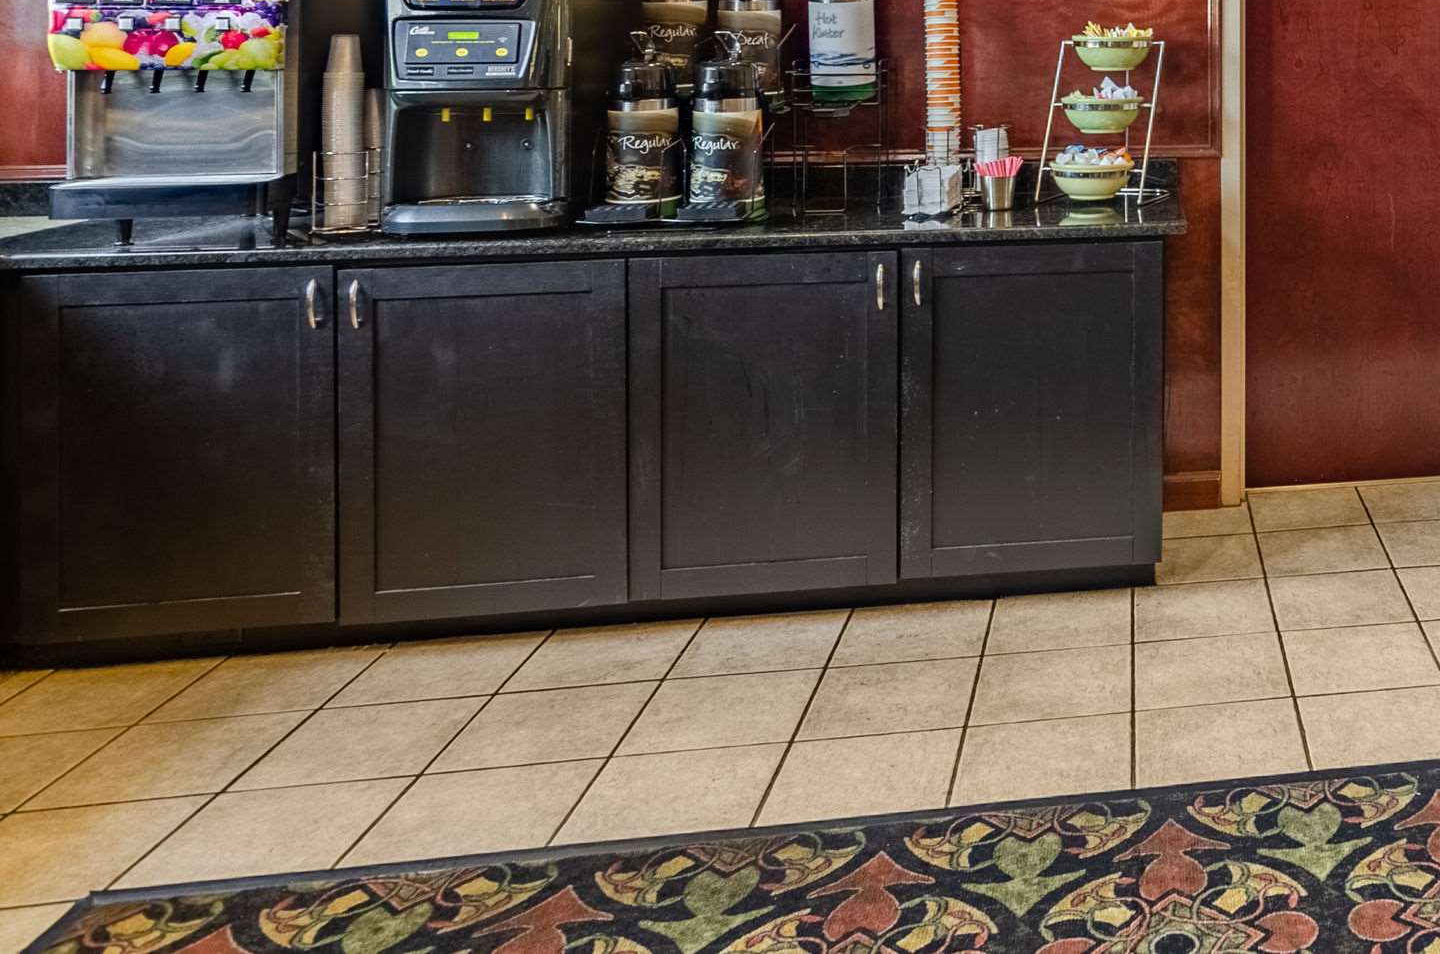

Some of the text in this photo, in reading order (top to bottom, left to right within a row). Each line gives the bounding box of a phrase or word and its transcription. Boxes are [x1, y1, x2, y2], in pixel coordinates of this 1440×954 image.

[815, 11, 838, 25] Hot
[650, 25, 697, 43] Regular
[735, 30, 770, 49] Decaf
[617, 135, 674, 155] Regular
[692, 135, 740, 156] Regular
